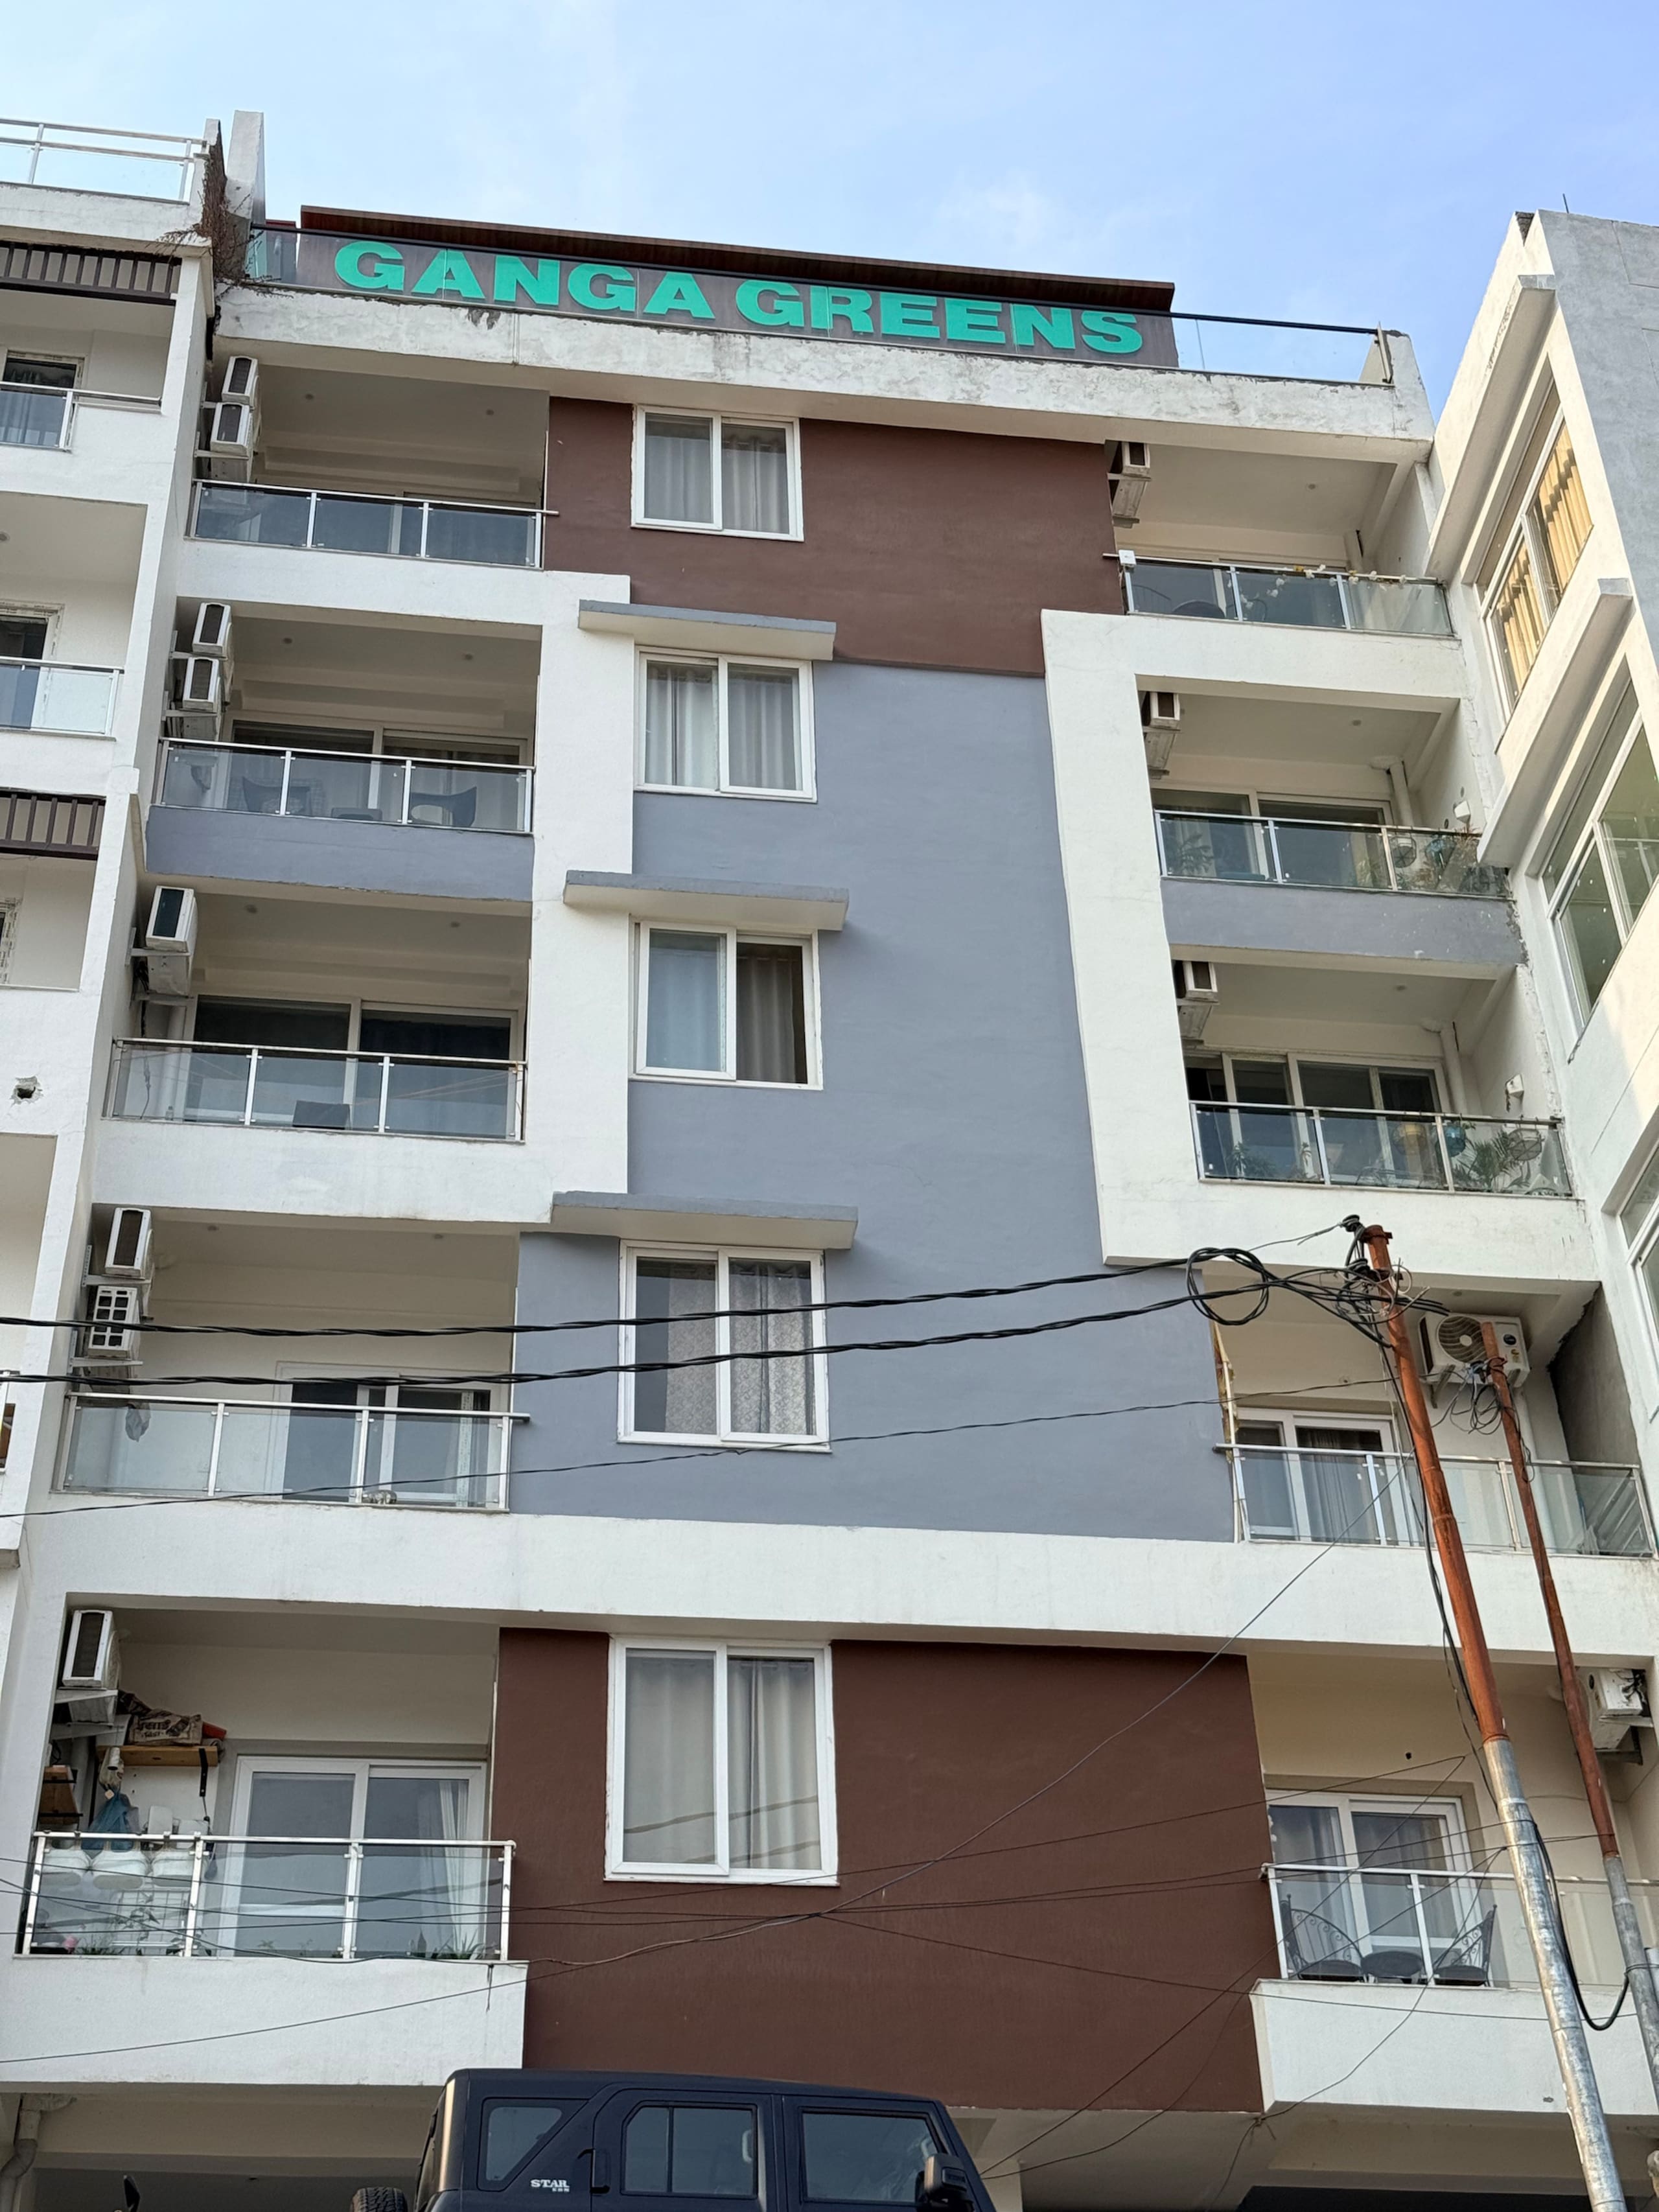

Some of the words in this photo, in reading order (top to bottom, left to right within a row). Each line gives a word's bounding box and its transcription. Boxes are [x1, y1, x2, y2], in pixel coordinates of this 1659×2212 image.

[334, 239, 714, 321] GANGA
[735, 278, 1144, 355] GREENS
[530, 2179, 570, 2188] STAR
